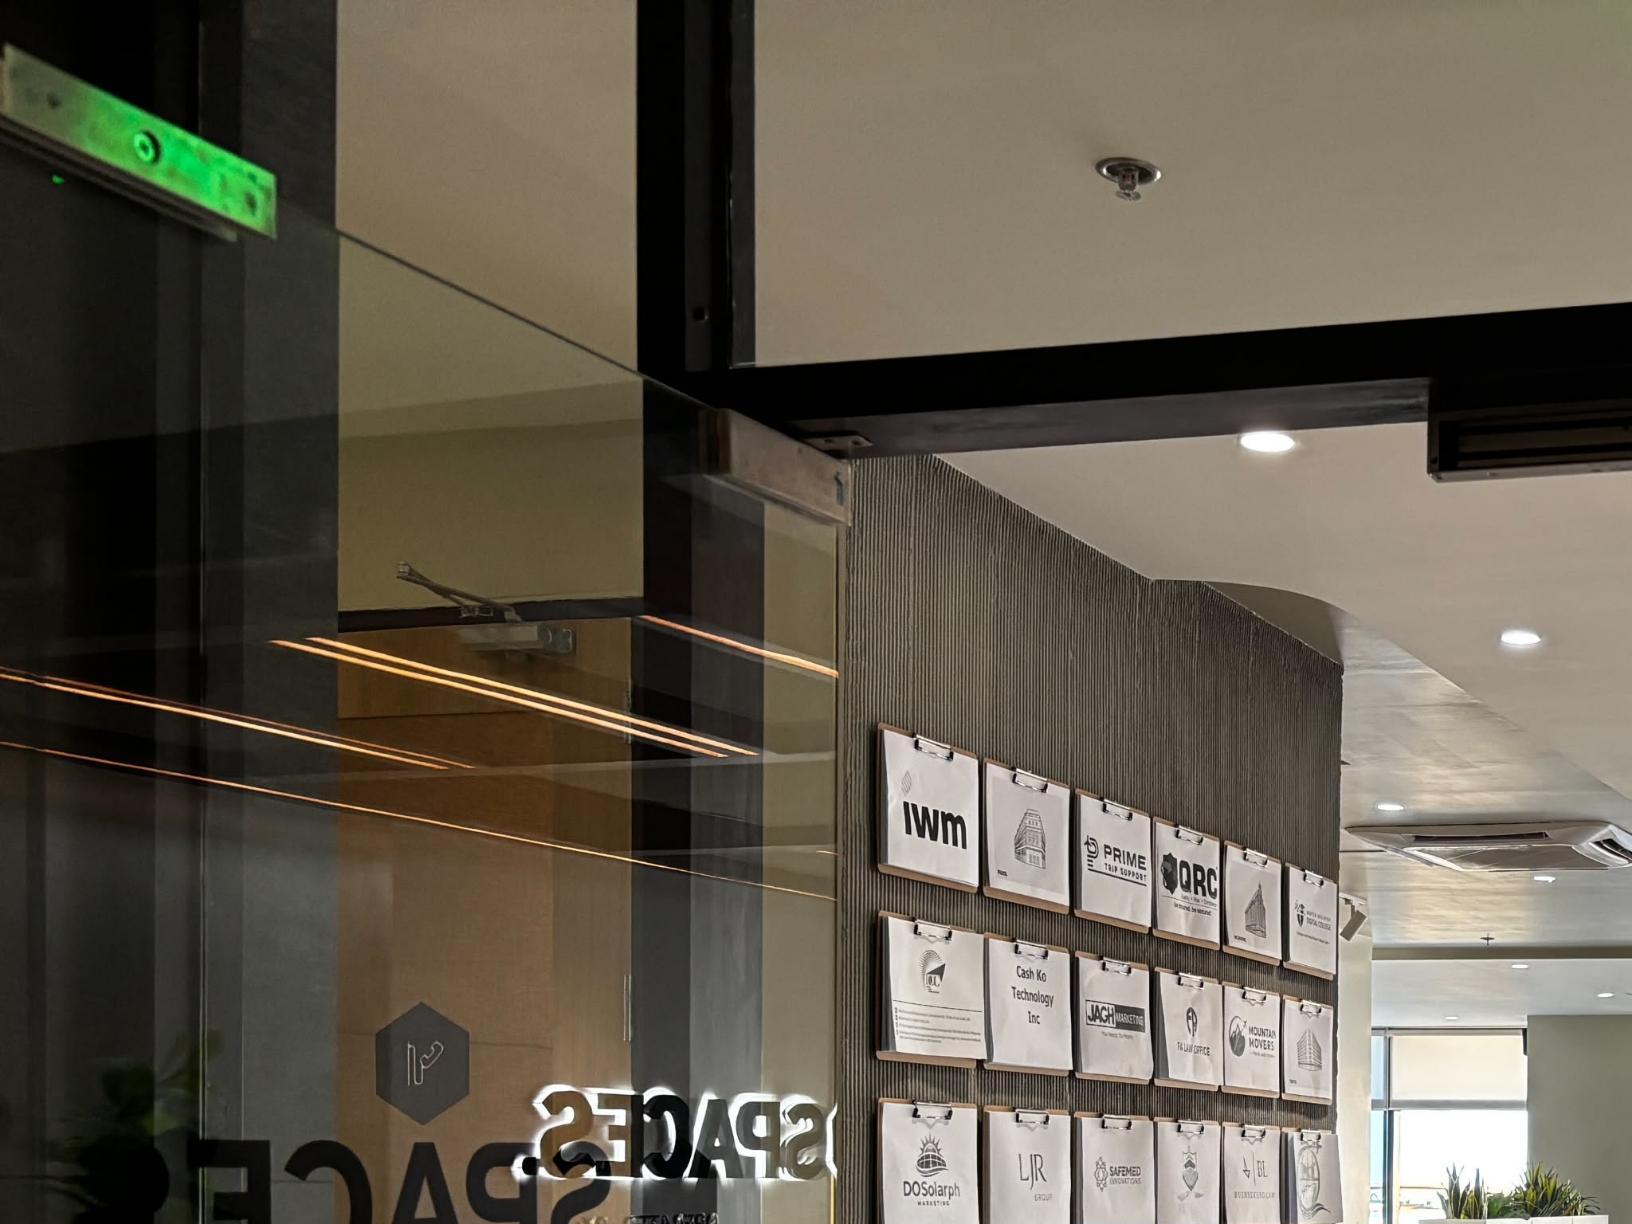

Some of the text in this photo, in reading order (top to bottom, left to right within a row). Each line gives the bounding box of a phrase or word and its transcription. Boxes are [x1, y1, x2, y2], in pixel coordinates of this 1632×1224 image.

[1104, 844, 1147, 871] PRIME
[1120, 867, 1147, 882] SUPPORT
[1179, 860, 1217, 899] QRC
[1016, 966, 1047, 982] Cash Ko
[1012, 986, 1054, 1007] Technology
[1028, 1011, 1041, 1025] Inc
[1088, 1004, 1144, 1025] JAGH MARKETING
[1249, 1026, 1277, 1039] MOUNTAIN
[1194, 1044, 1211, 1056] OFFICE
[1249, 1037, 1275, 1051] MOVERS
[1018, 1153, 1047, 1190] LJR
[1110, 1166, 1141, 1176] SAFEMED
[903, 1180, 961, 1200] DOSolarph
